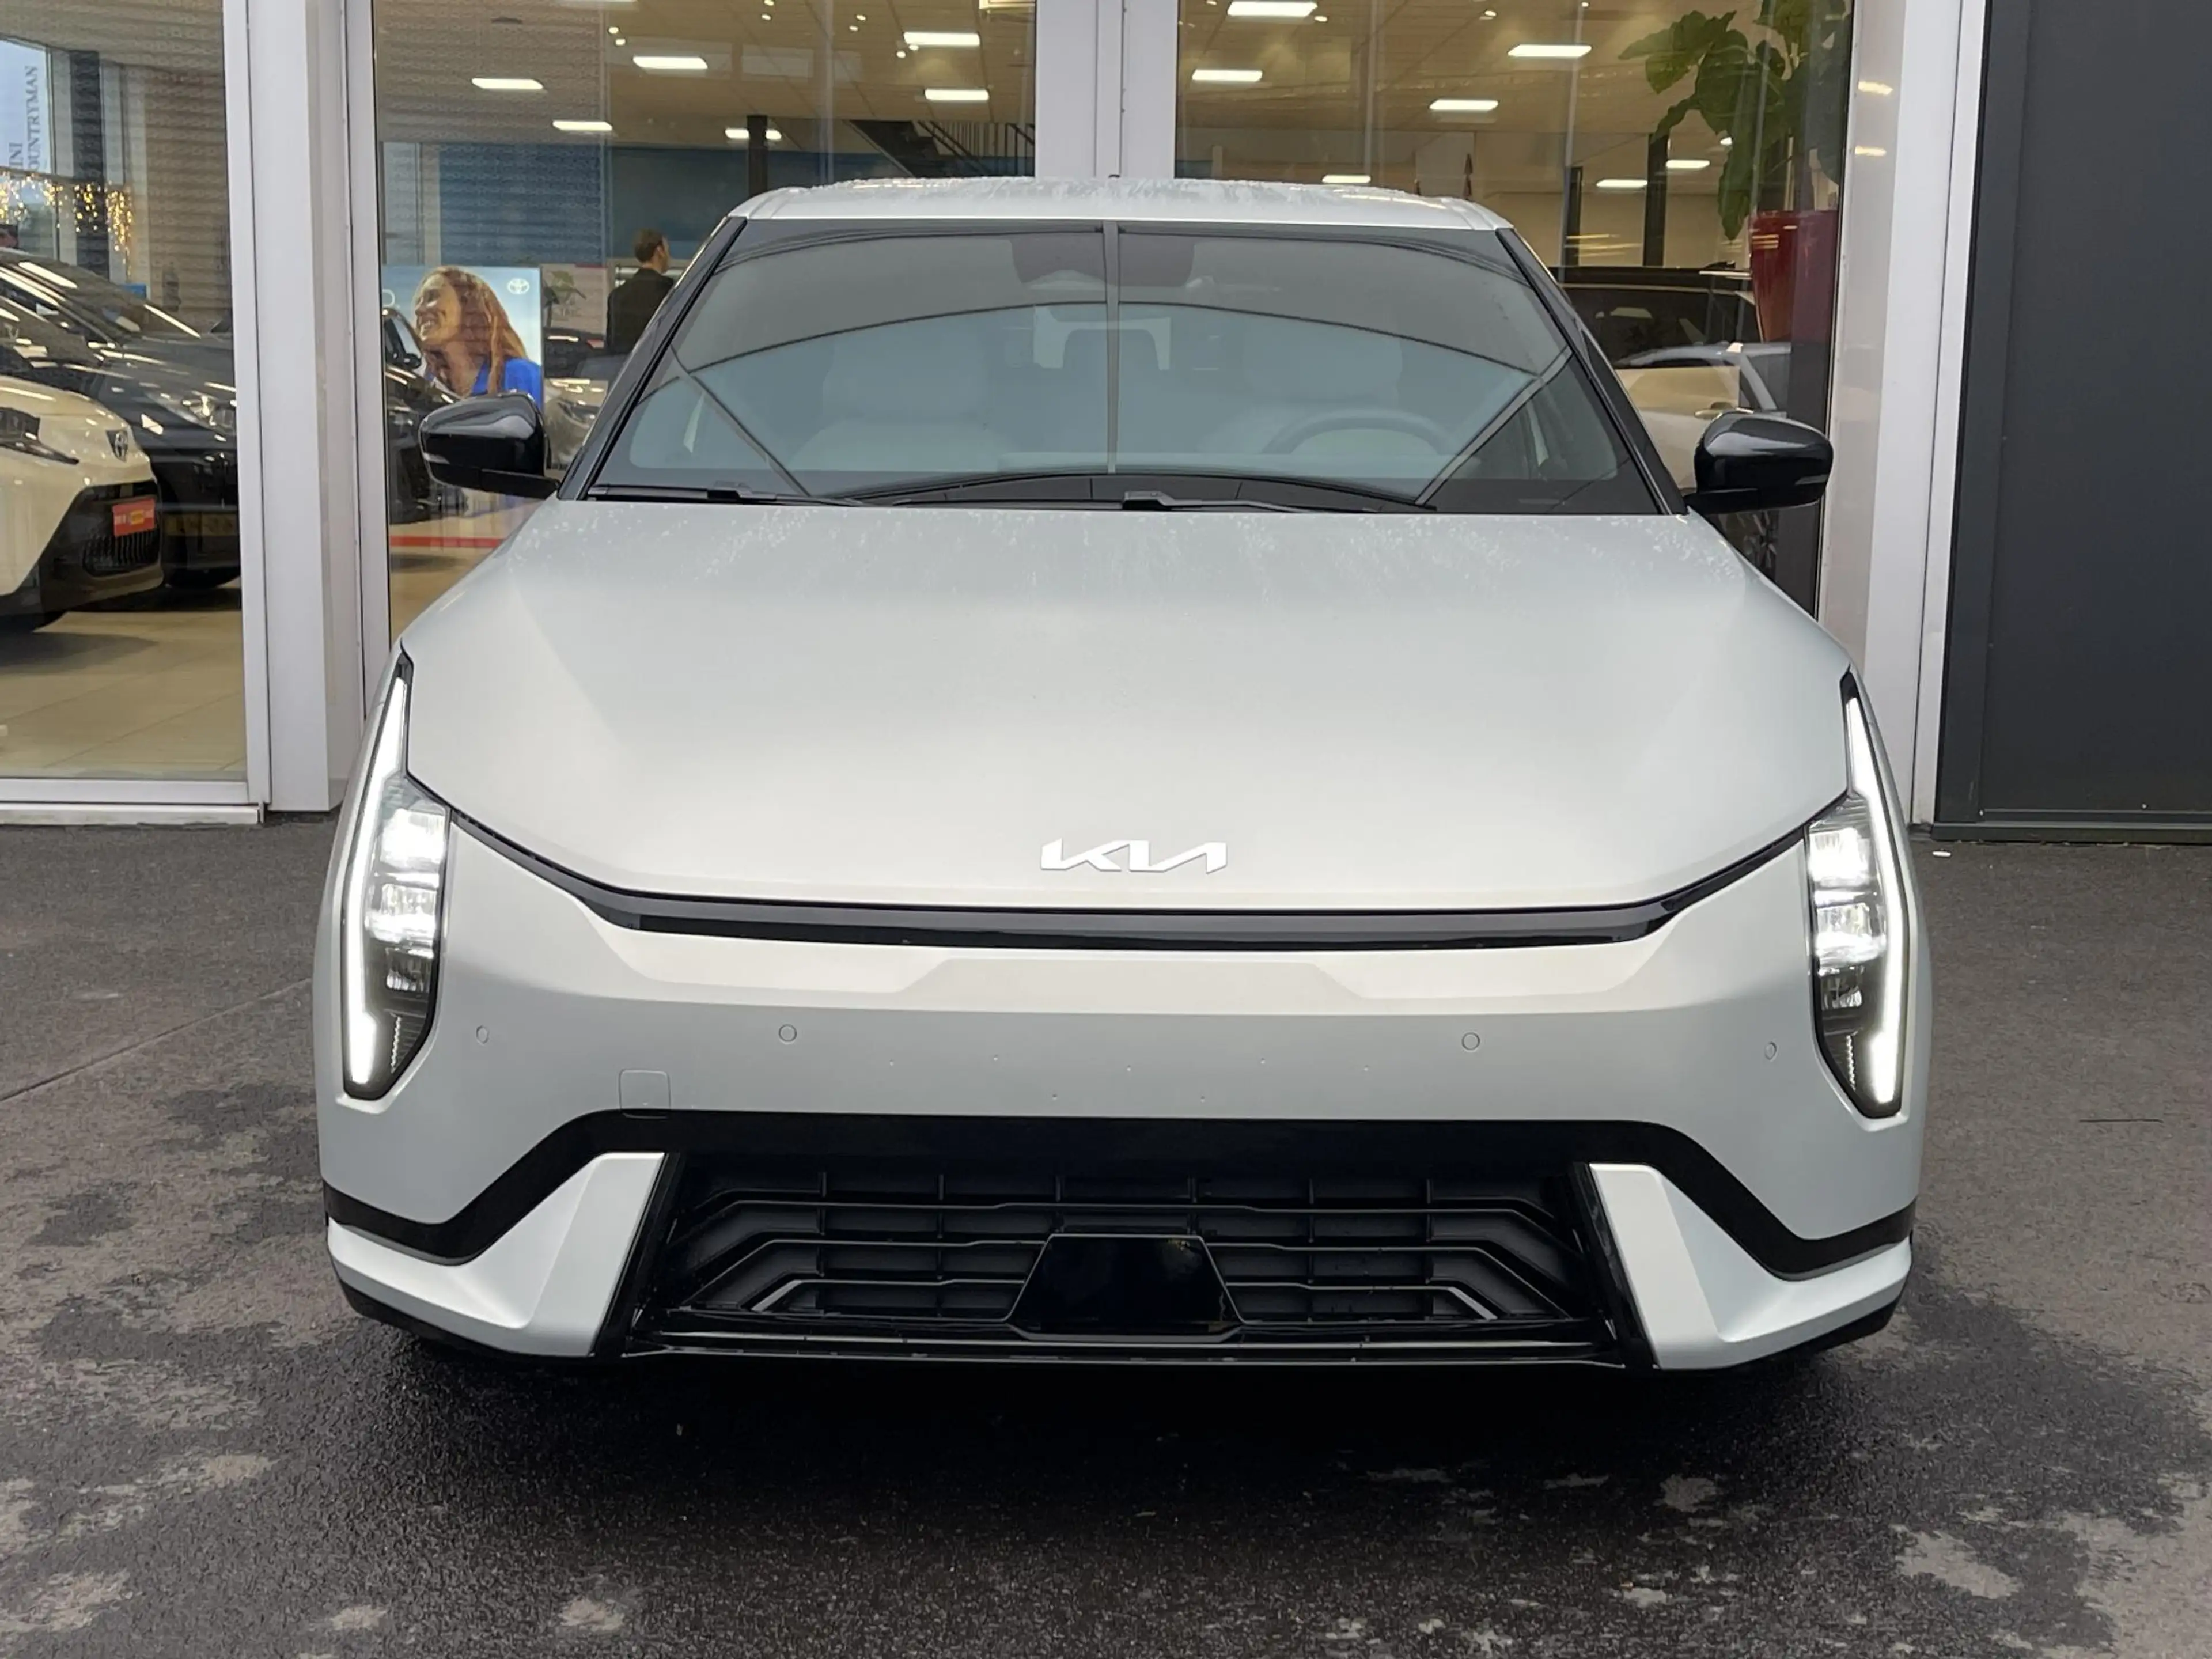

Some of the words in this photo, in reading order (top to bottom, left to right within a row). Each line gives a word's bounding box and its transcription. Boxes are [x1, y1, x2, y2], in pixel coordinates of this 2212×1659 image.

[25, 65, 41, 171] OUNTRYMAN
[9, 142, 24, 172] INI
[1040, 838, 1228, 874] KIA
